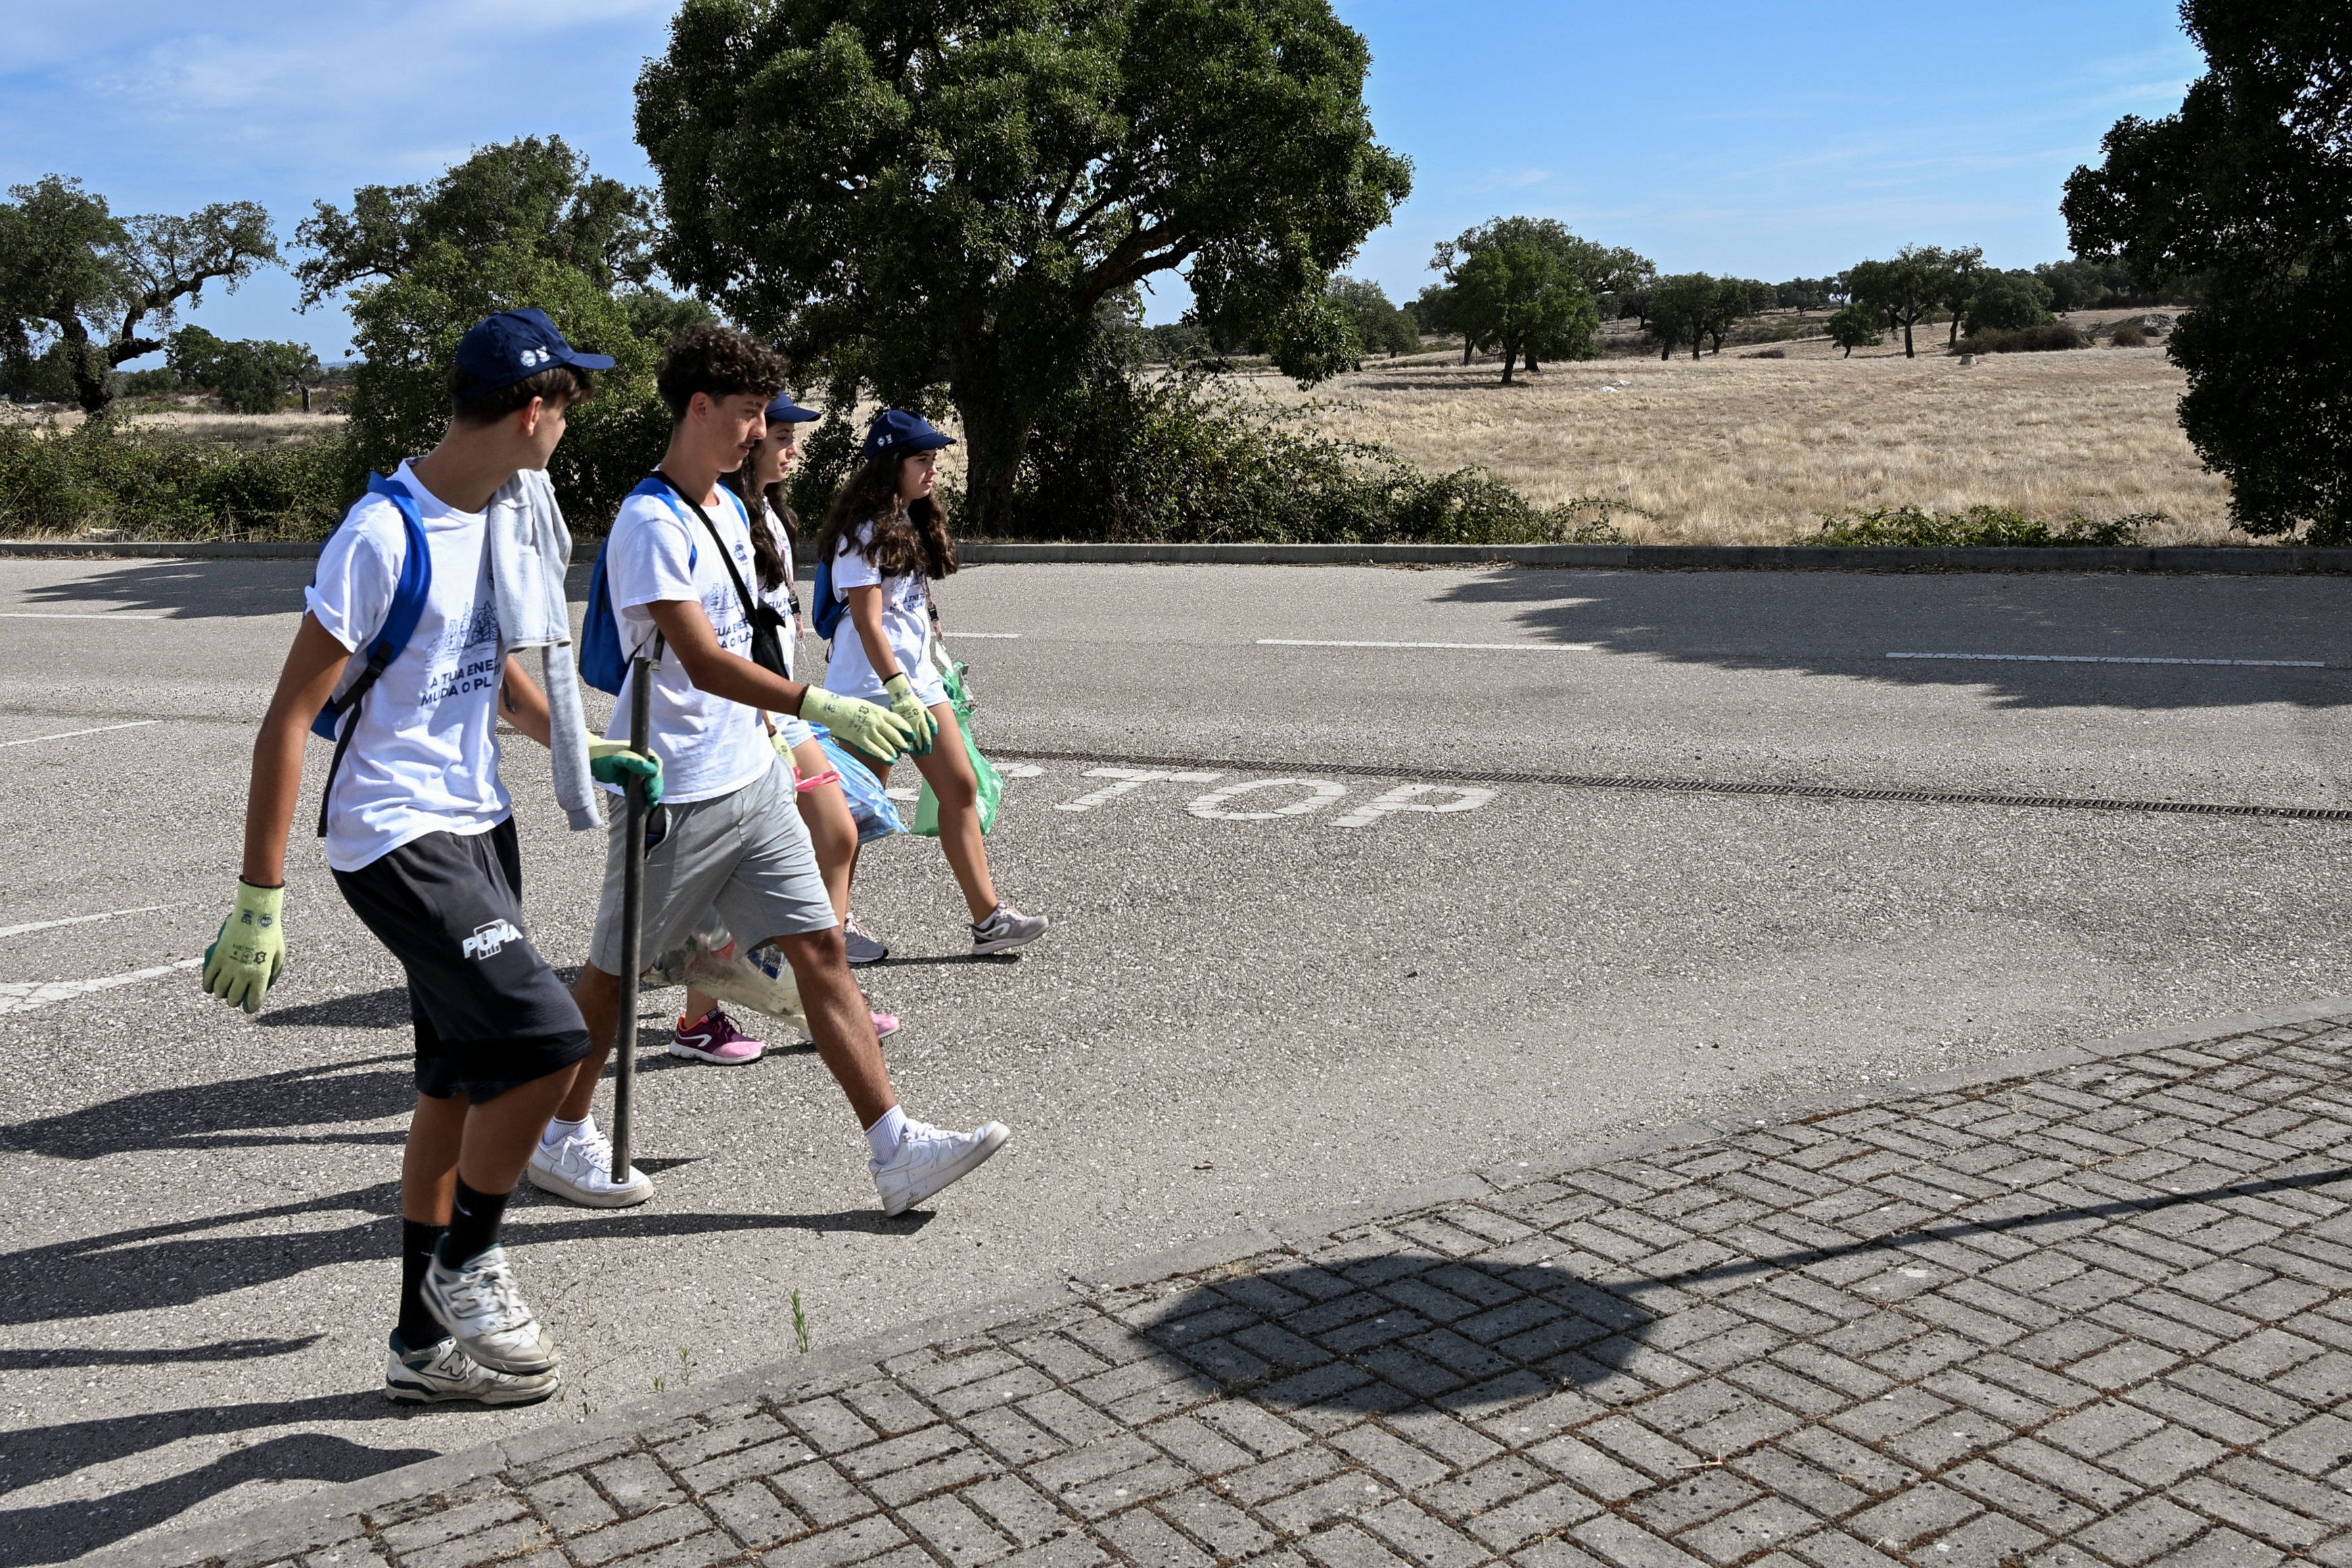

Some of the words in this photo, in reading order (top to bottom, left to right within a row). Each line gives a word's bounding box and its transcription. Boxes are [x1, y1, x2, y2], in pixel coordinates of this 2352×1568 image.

[430, 677, 438, 689] A
[441, 668, 465, 685] TUA
[420, 685, 459, 706] MUDA
[461, 681, 471, 693] O
[462, 924, 524, 959] PUMA
